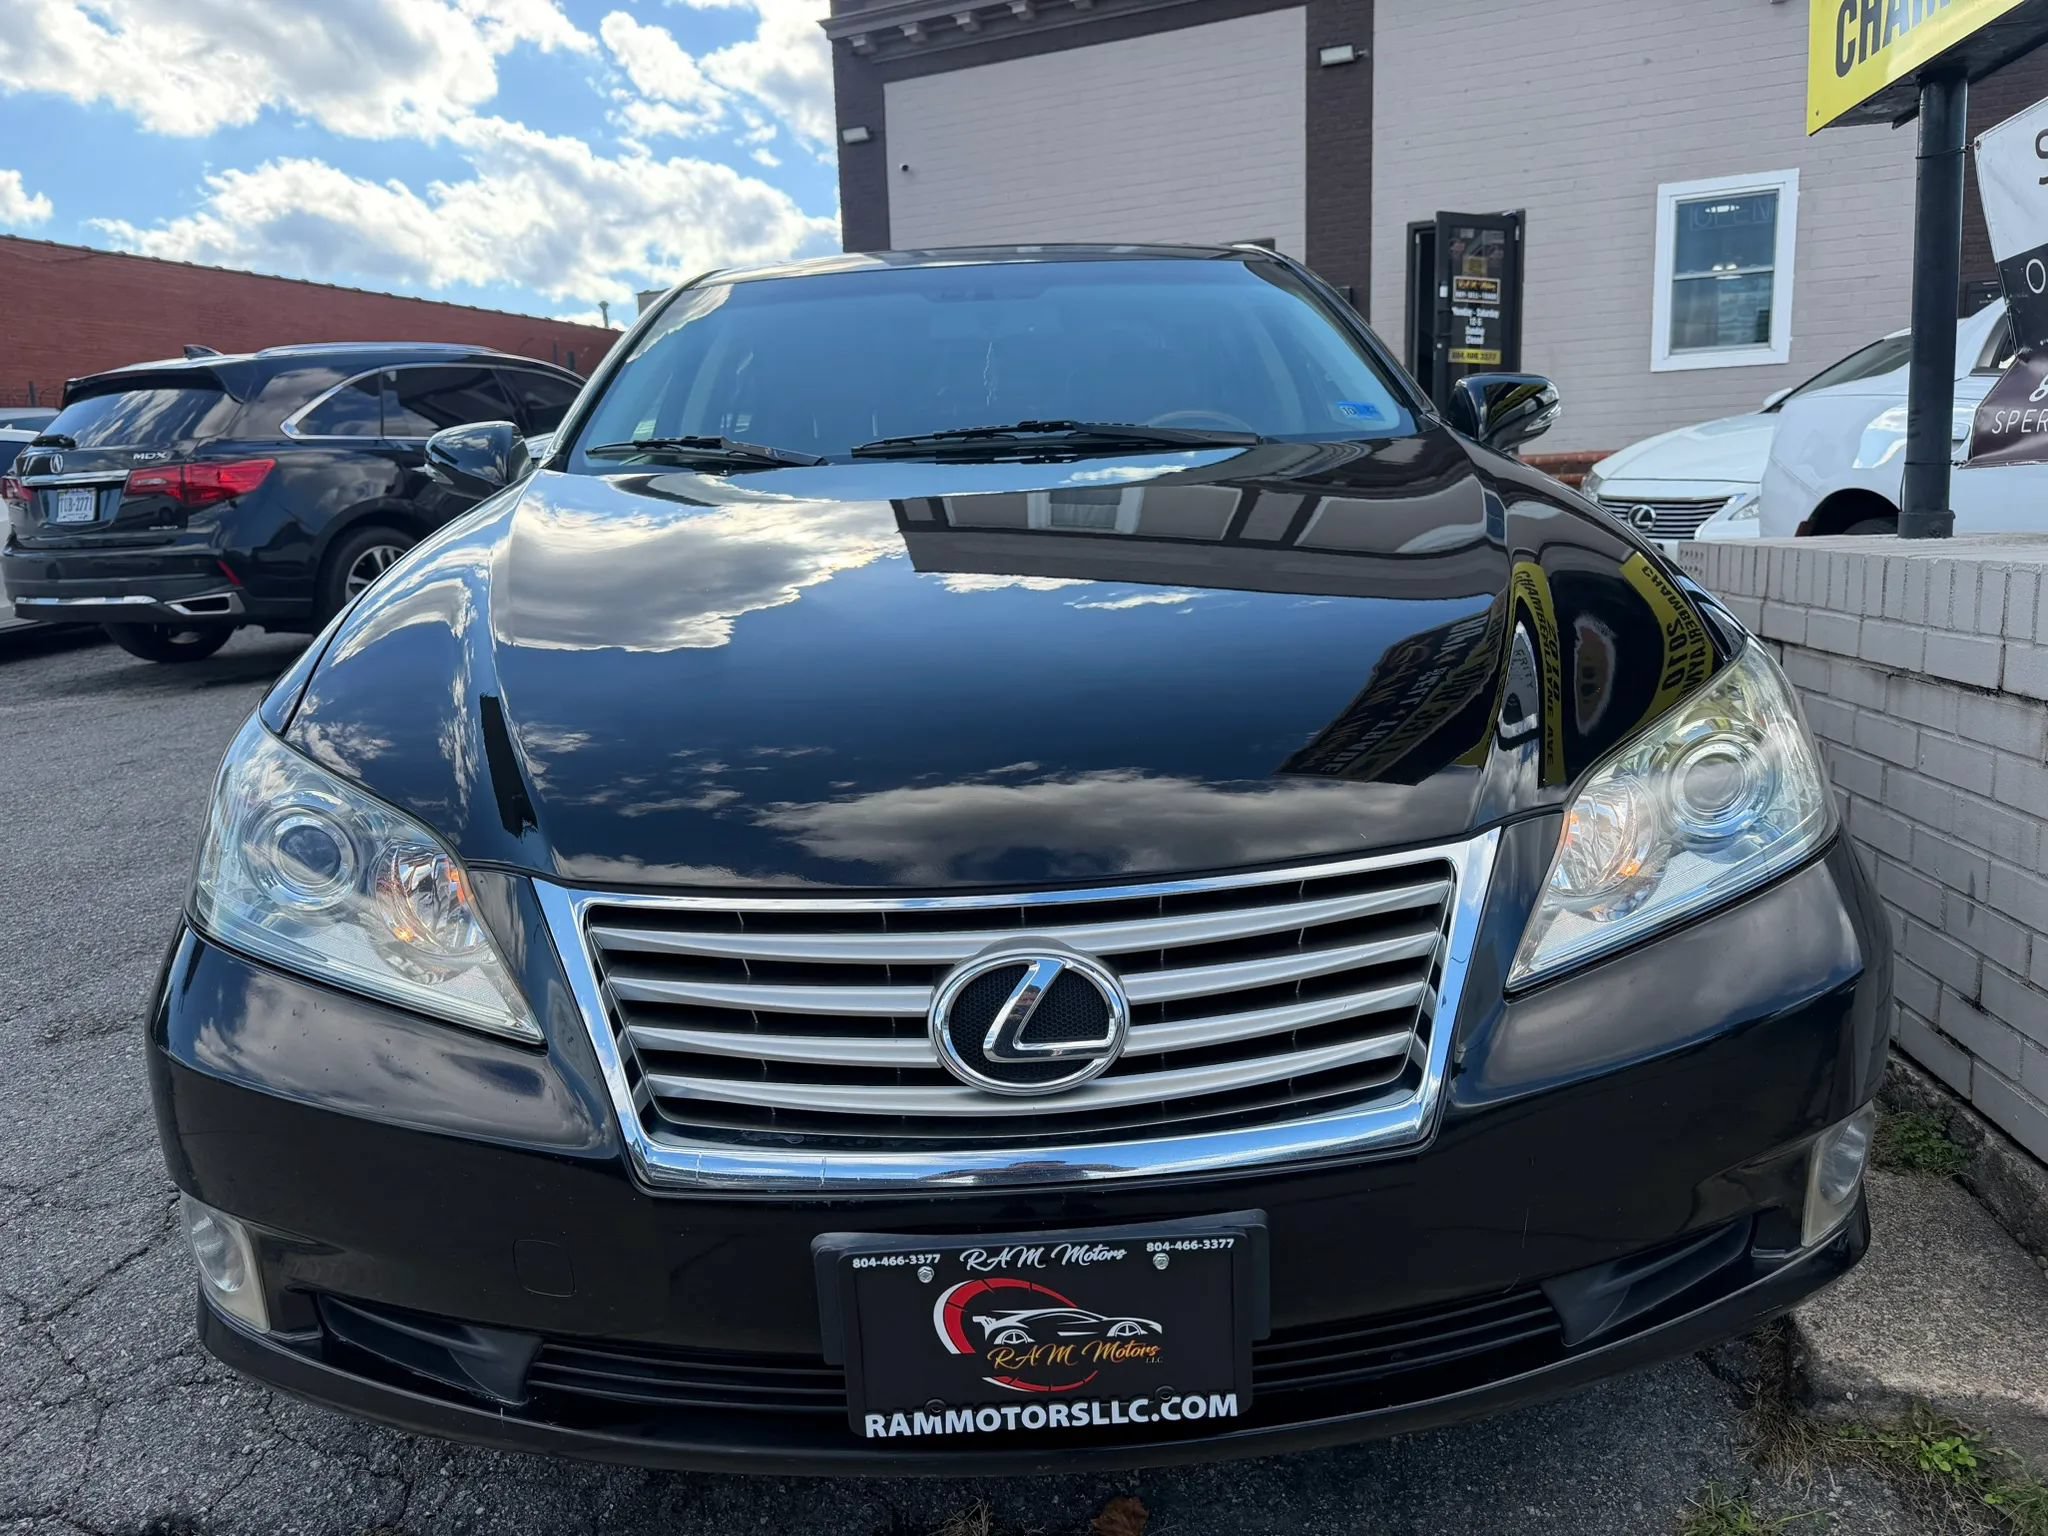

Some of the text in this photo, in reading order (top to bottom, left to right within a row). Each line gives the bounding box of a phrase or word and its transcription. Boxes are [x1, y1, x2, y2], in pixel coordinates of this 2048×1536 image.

[133, 452, 168, 460] MDX
[853, 1239, 1234, 1271] 804-466-3377 RAM Motors 804-466-3377
[987, 1340, 1161, 1369] RAM Motors
[865, 1393, 1238, 1438] RAMMOTORSLLC.COM
